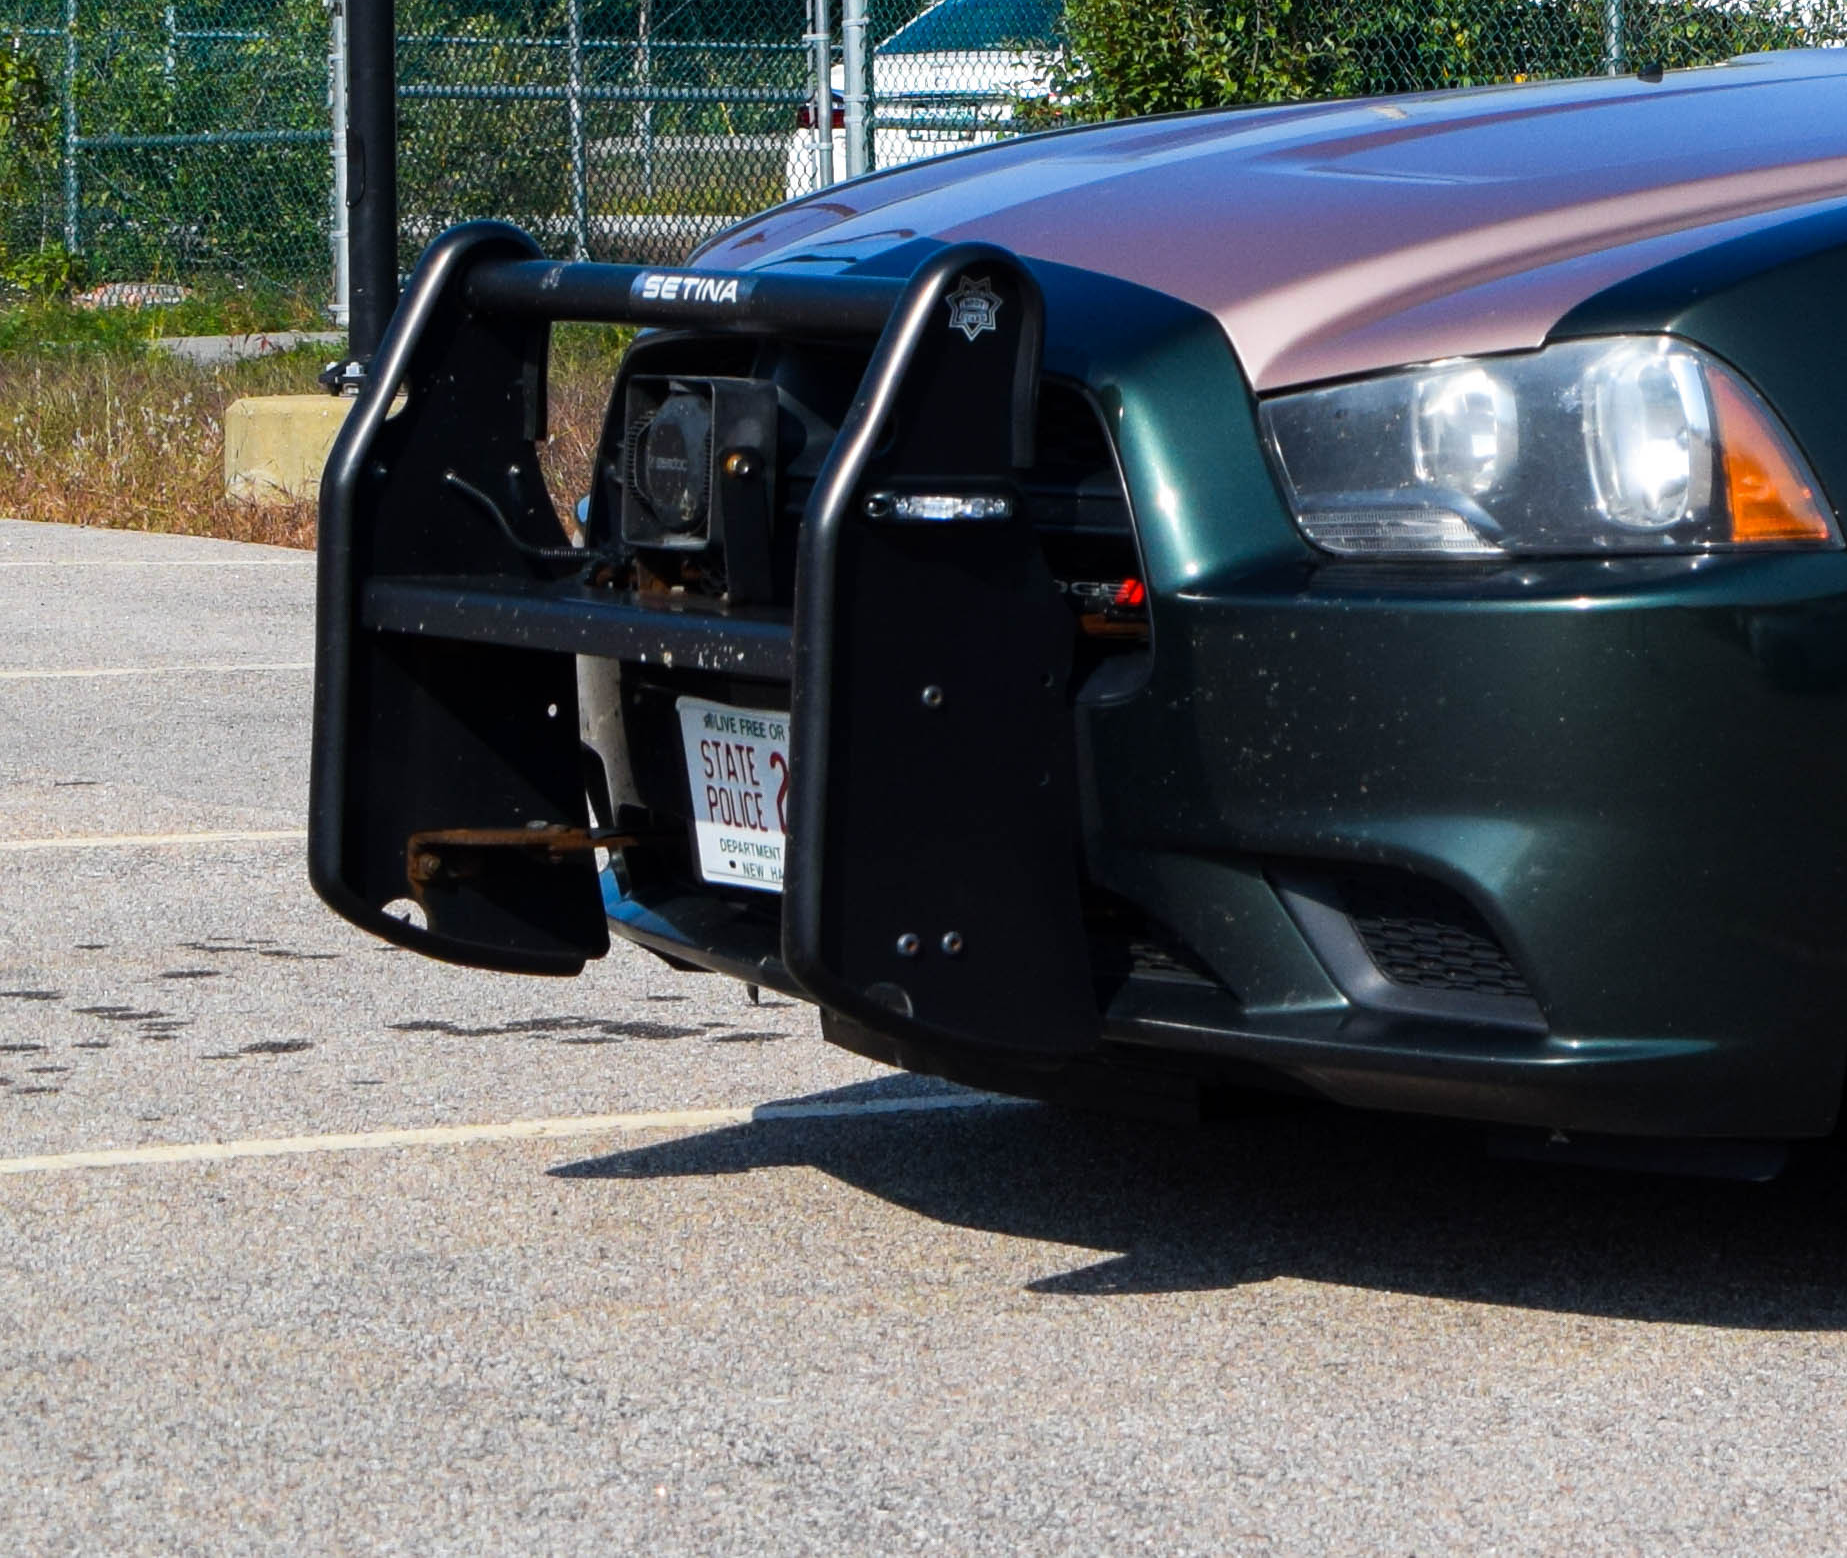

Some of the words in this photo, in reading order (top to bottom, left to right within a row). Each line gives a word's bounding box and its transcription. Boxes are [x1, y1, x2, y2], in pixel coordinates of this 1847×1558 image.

[642, 275, 738, 303] SETINA
[715, 714, 736, 735] LIVE
[740, 718, 766, 739] FREE
[769, 723, 785, 742] OR
[701, 740, 760, 787] STATE
[706, 784, 768, 832] POLICE
[719, 837, 782, 860] DEPARTMENT
[742, 862, 765, 879] NEW
